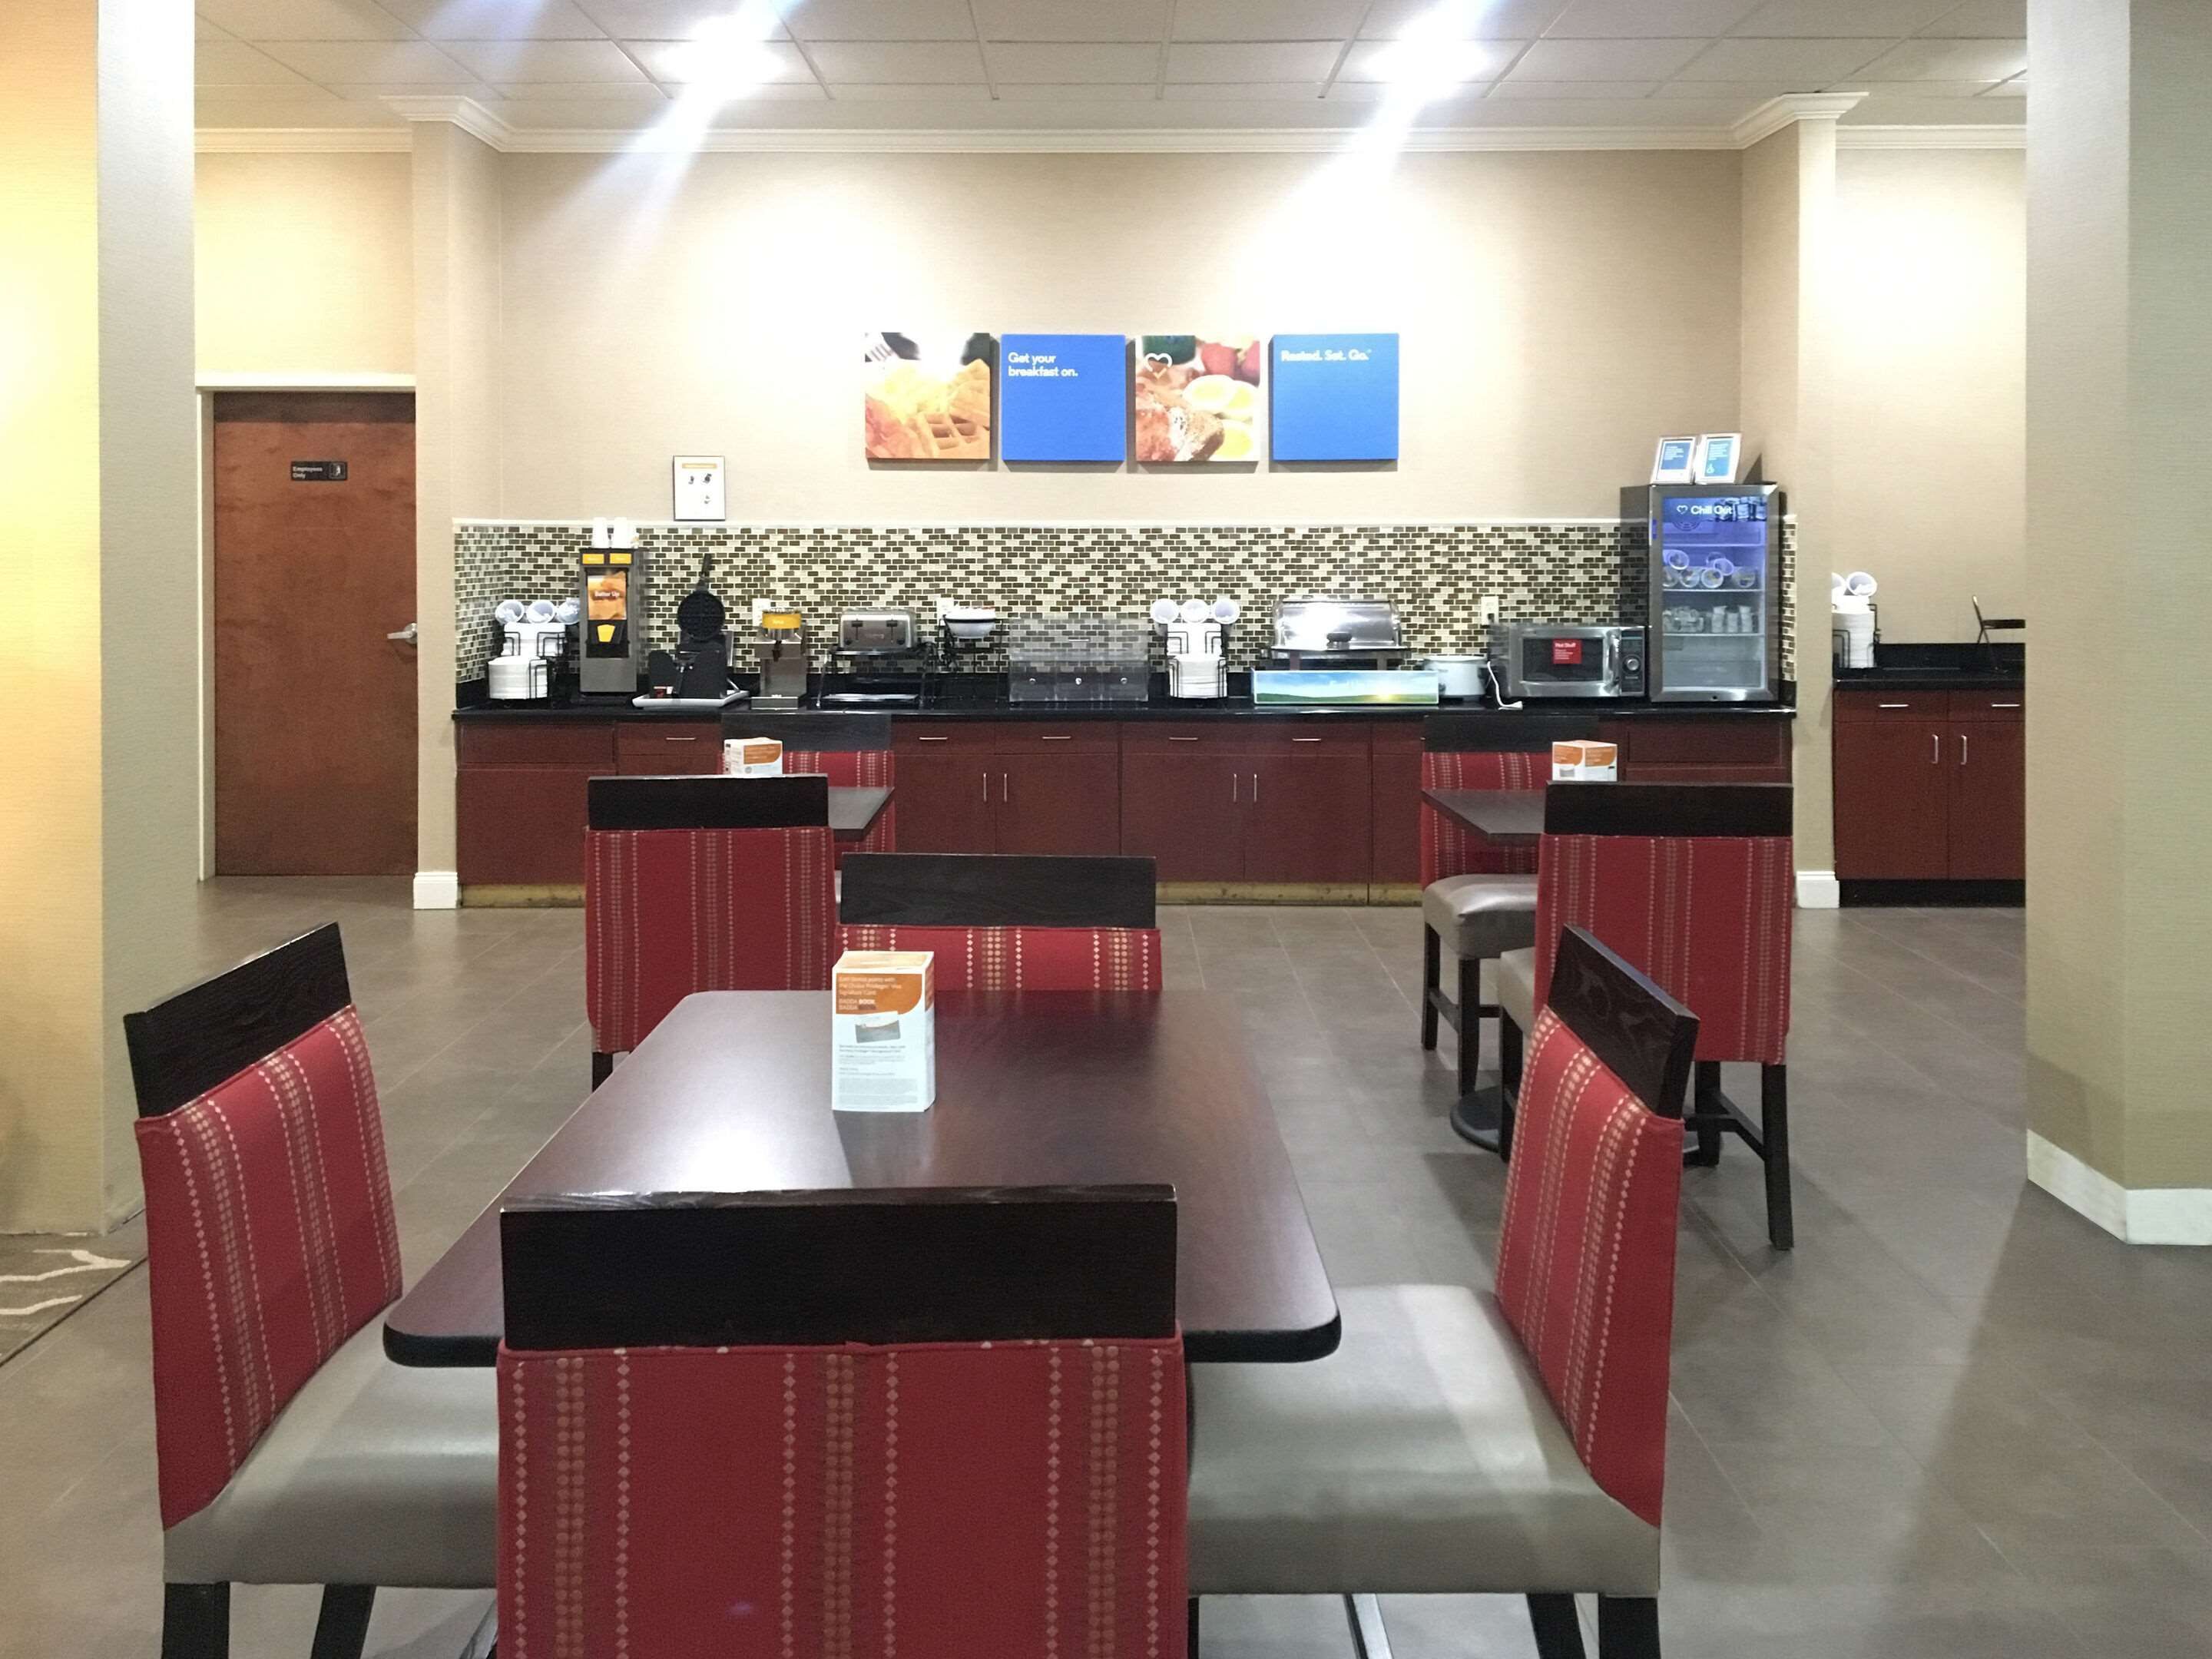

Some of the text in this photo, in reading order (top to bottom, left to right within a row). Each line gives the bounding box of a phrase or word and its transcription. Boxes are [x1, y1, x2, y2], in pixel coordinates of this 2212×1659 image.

[1008, 352, 1057, 366] Get your
[1008, 365, 1079, 376] breakfast on.
[1690, 505, 1734, 515] Chill Out
